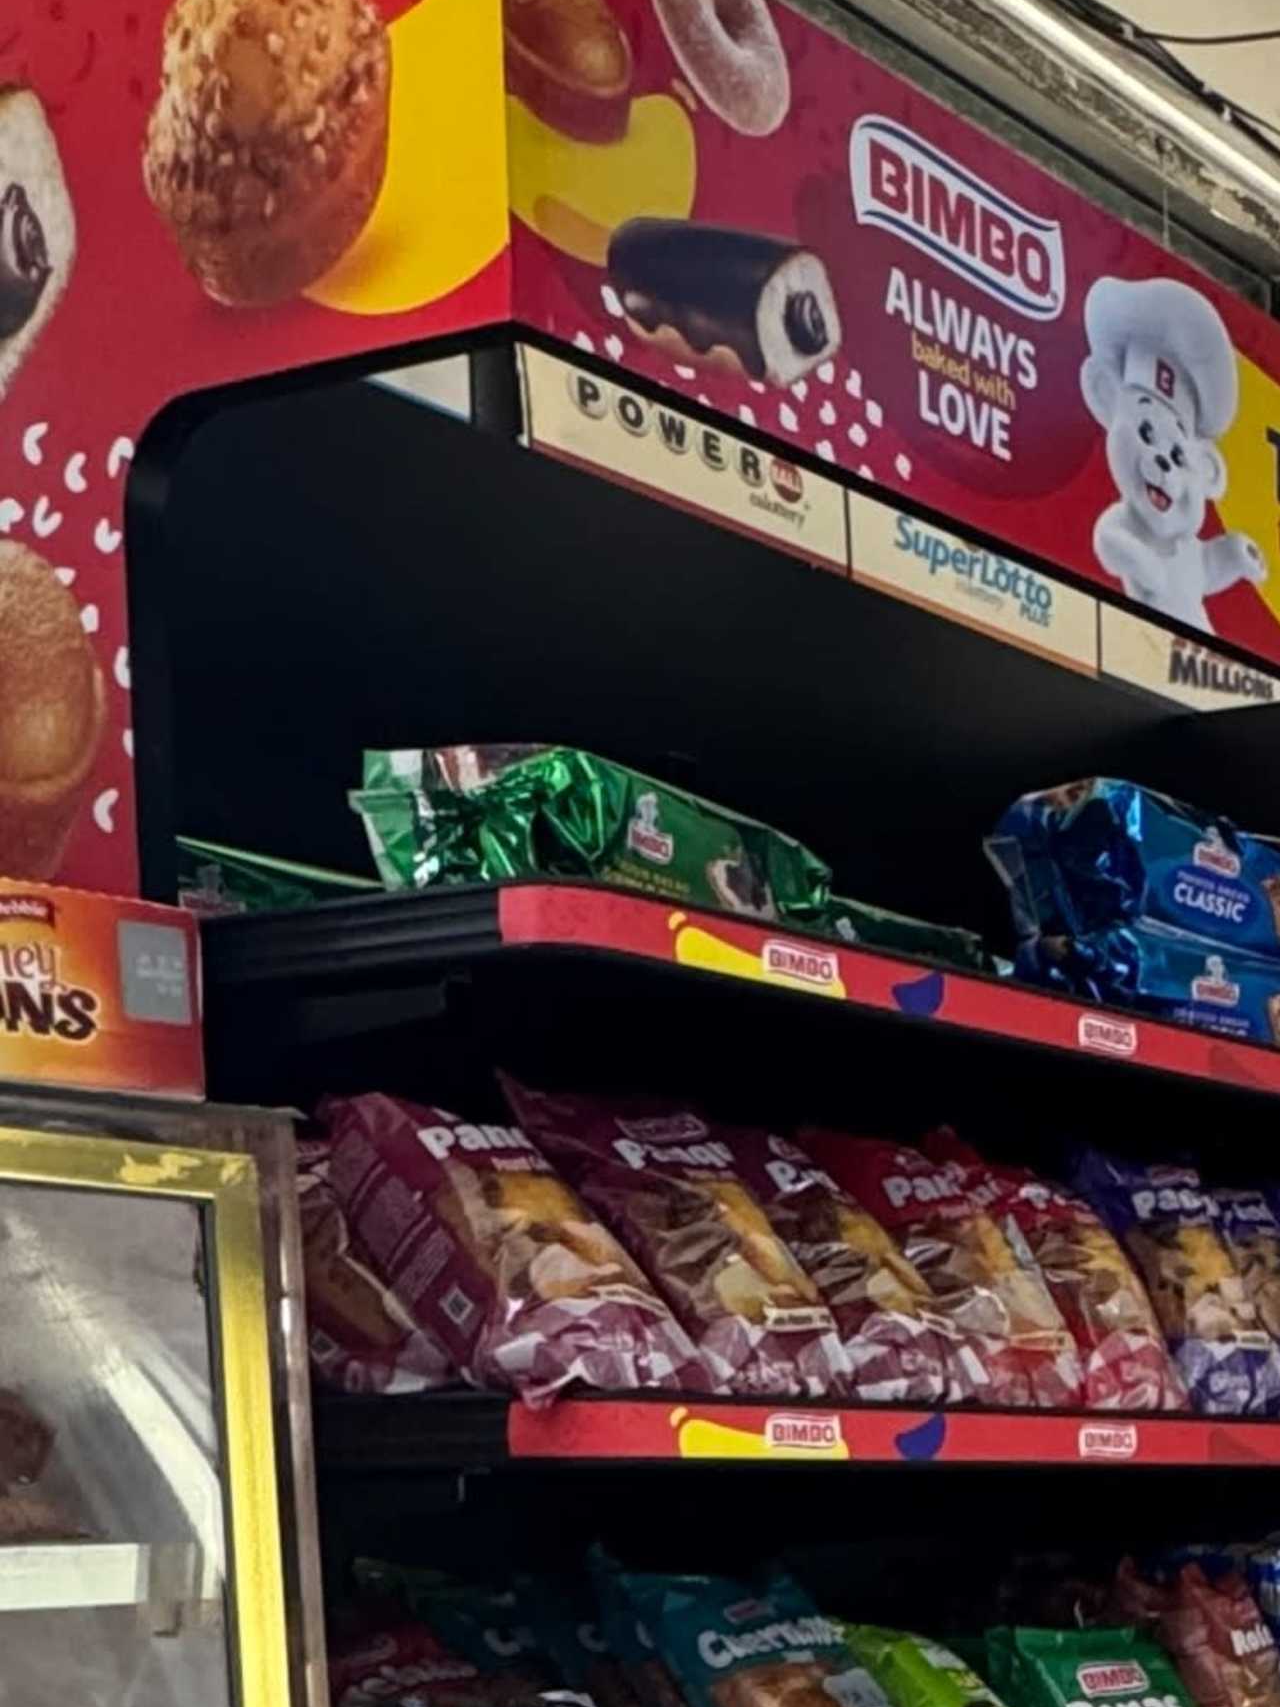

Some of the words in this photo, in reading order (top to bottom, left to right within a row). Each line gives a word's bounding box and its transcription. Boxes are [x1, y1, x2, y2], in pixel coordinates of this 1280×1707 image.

[868, 138, 1051, 297] BIMBO
[885, 268, 1038, 389] ALWAYS
[911, 333, 972, 389] baked
[973, 364, 1017, 411] with
[577, 378, 762, 481] POWER
[918, 371, 1013, 462] LOVE
[1168, 656, 1275, 700] MILLIONS
[1173, 882, 1248, 923] CLASSIC
[768, 948, 834, 981] BIMBO
[772, 1422, 835, 1444] BIMBO
[1081, 1664, 1145, 1692] BIMBO
